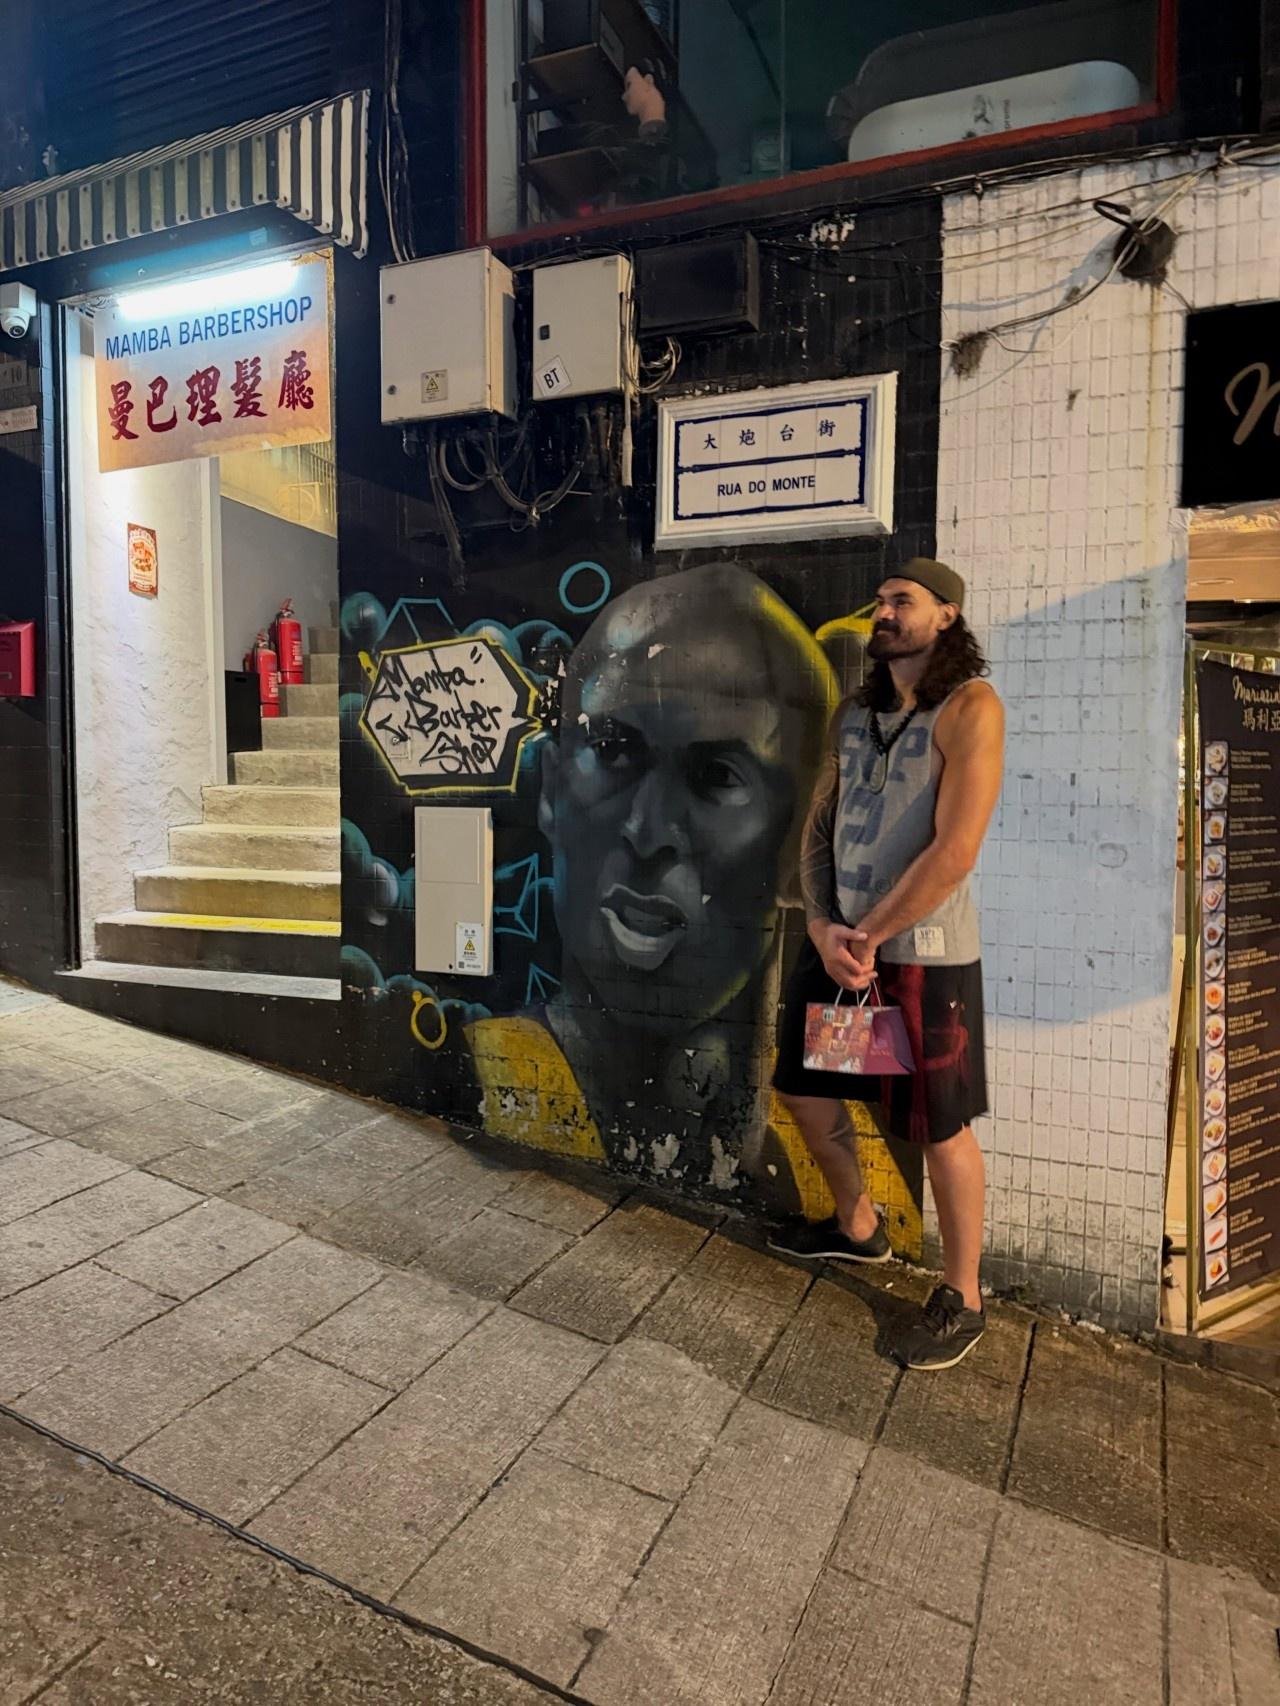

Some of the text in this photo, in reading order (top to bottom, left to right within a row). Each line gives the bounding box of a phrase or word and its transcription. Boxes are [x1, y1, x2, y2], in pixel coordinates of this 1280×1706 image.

[106, 295, 313, 361] MAMBA BARBERSHOP
[544, 367, 561, 390] BT
[107, 349, 315, 441] 曼巴理髮廳
[703, 419, 837, 450] 大炮台街
[717, 474, 817, 498] RUA DO MONTE
